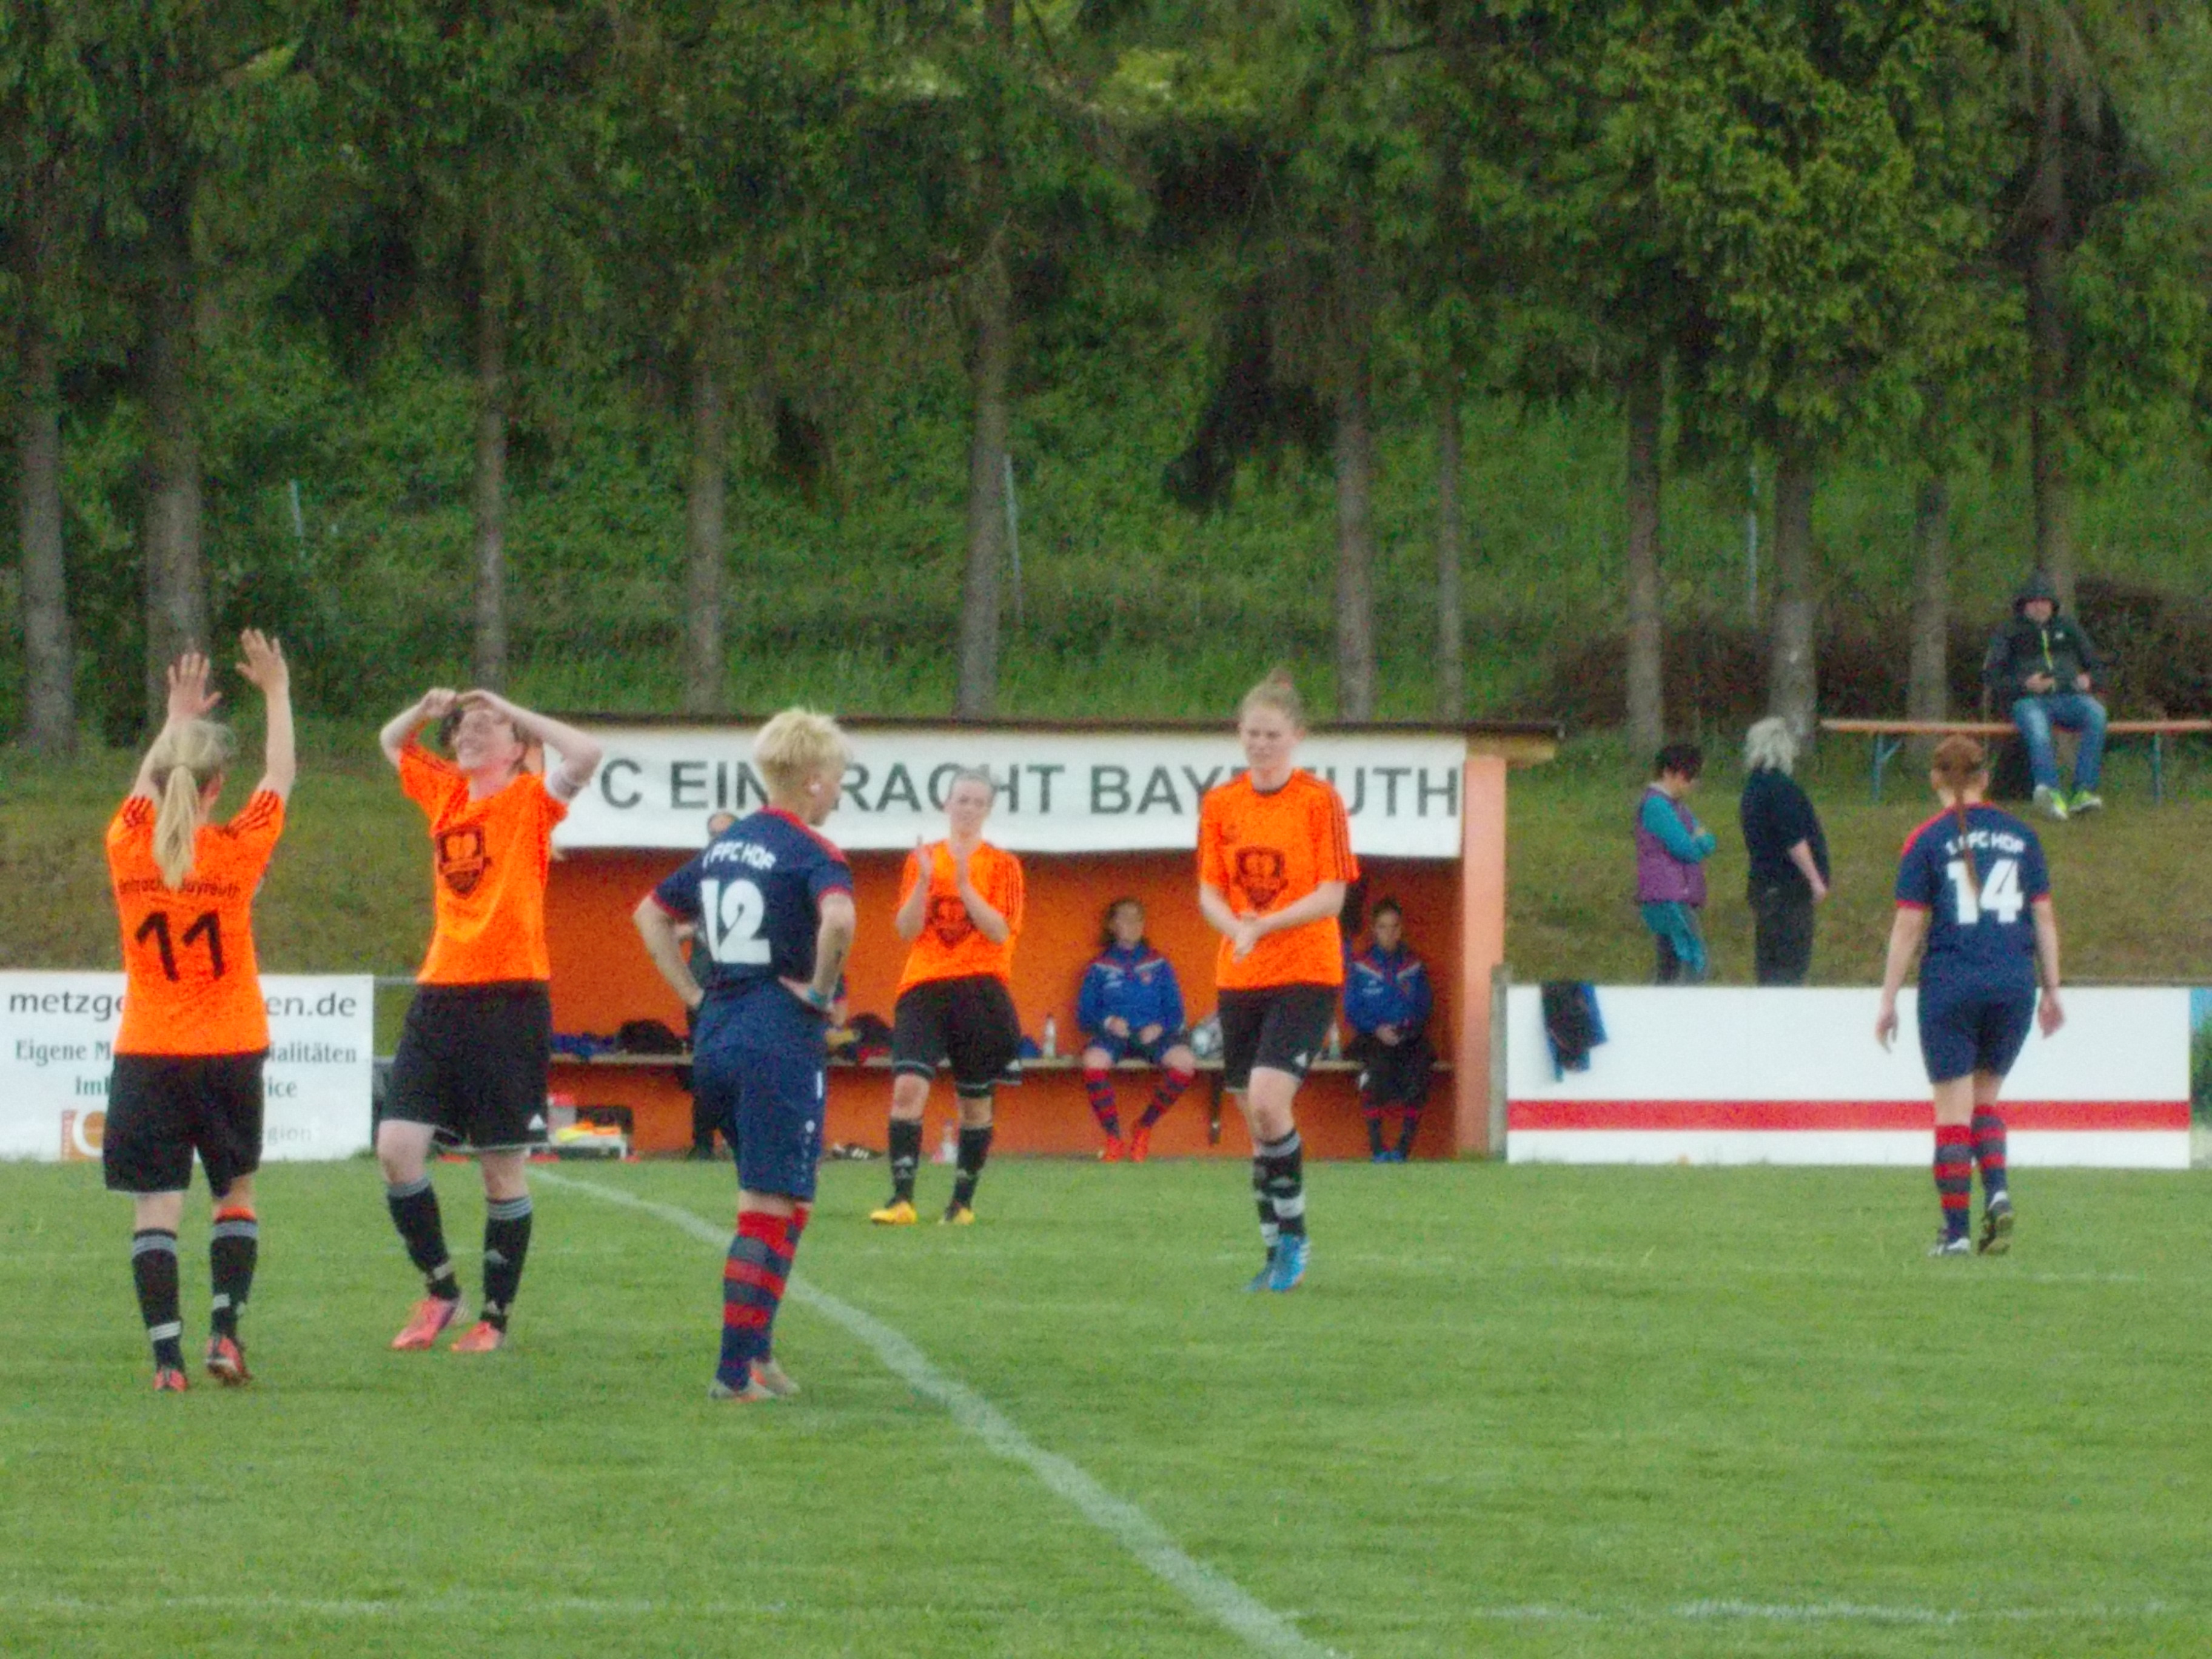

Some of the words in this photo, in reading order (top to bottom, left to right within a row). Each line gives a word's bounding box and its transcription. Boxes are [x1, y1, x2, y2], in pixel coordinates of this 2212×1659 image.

[600, 758, 643, 809] C
[670, 759, 1066, 813] EINRACHT
[1090, 764, 1459, 817] BAYUTH
[700, 879, 773, 965] 12
[1946, 859, 2023, 923] 14
[135, 910, 226, 982] 11
[15, 1038, 87, 1067] Eigene
